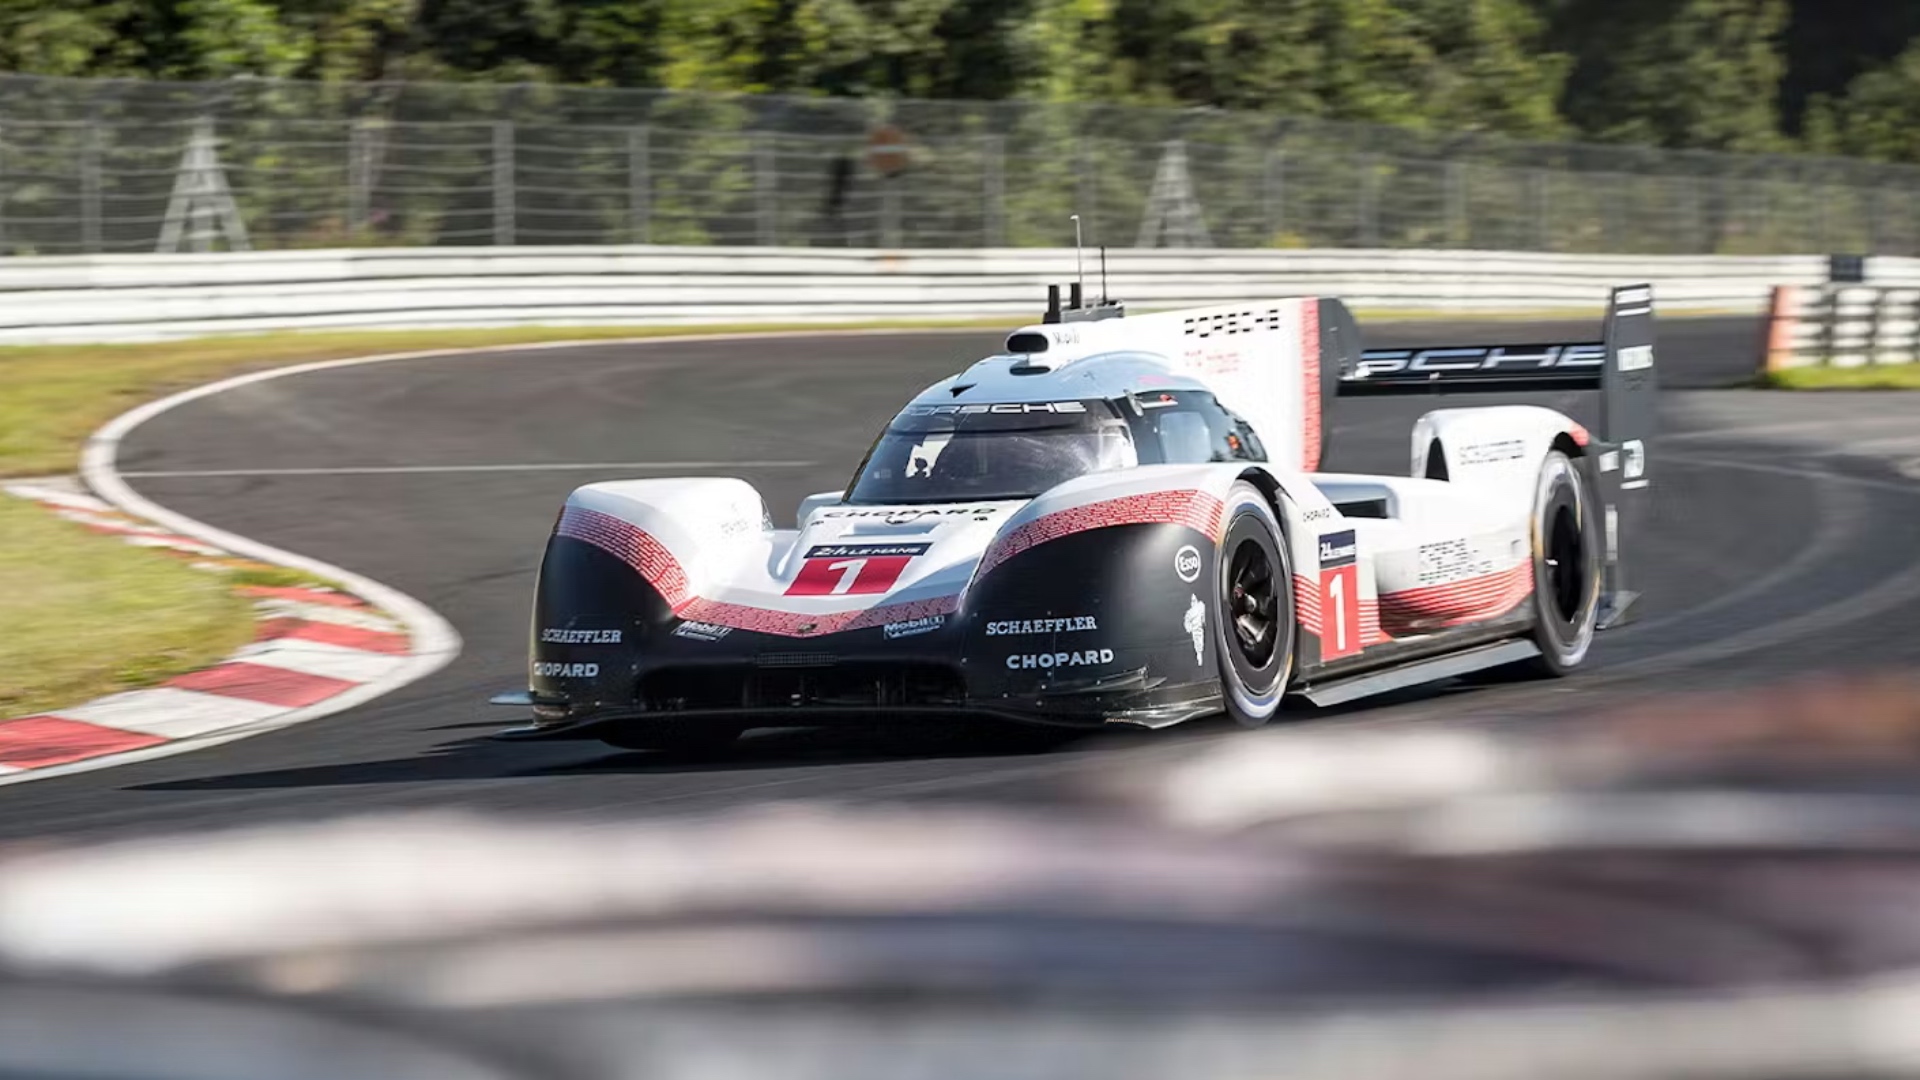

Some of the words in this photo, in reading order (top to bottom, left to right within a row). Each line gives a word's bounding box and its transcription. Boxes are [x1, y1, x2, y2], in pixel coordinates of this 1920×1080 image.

[1184, 309, 1279, 338] PORSCHE
[904, 401, 1087, 416] ORSCHE
[824, 508, 997, 519] CHOPARD
[1179, 555, 1198, 572] Esso
[828, 559, 869, 595] 1
[1329, 573, 1346, 651] 1
[884, 617, 928, 632] Mobil
[986, 616, 1097, 636] SCHAEFFLER
[541, 628, 622, 643] SCHAEFFLER
[1006, 648, 1114, 670] CHOPARD
